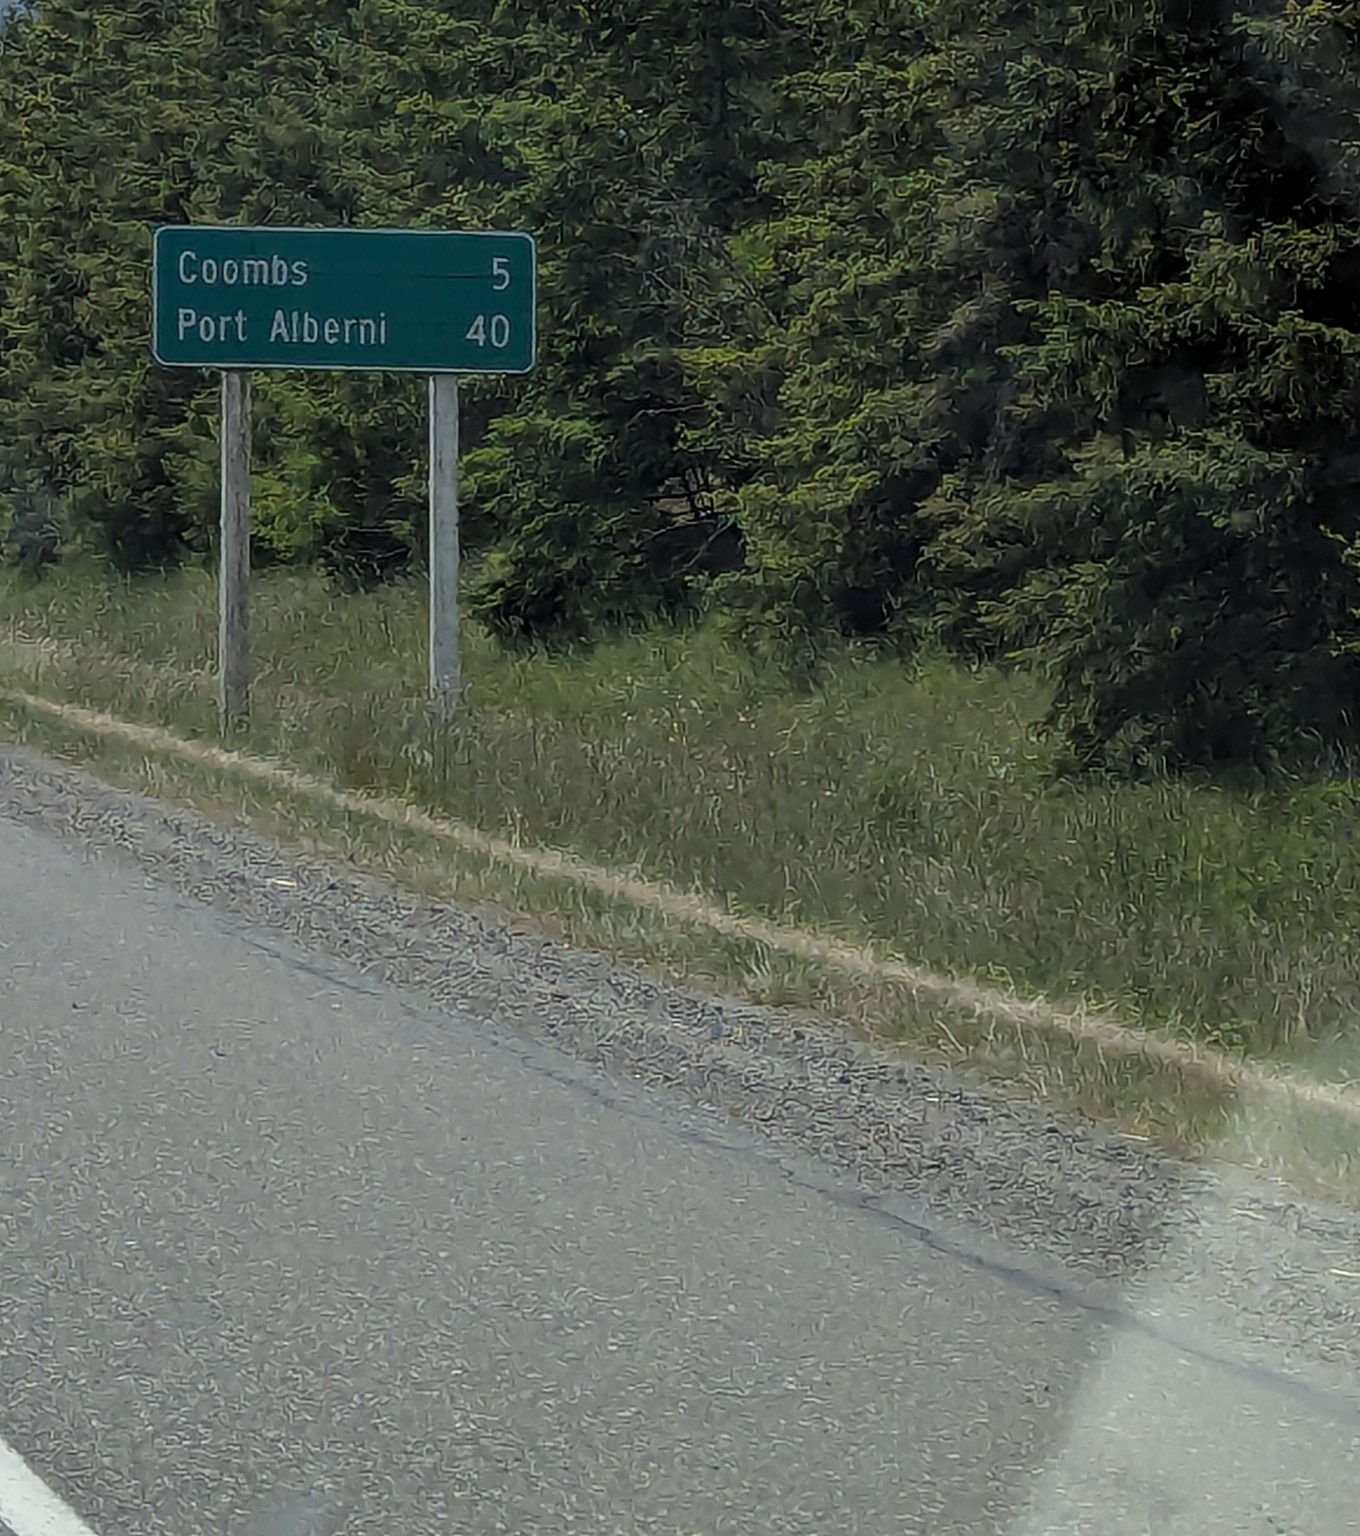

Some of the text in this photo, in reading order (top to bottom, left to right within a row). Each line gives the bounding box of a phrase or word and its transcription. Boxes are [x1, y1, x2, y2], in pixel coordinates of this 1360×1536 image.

[179, 250, 510, 290] Coombs 5
[178, 308, 510, 348] Port Alberni 40
